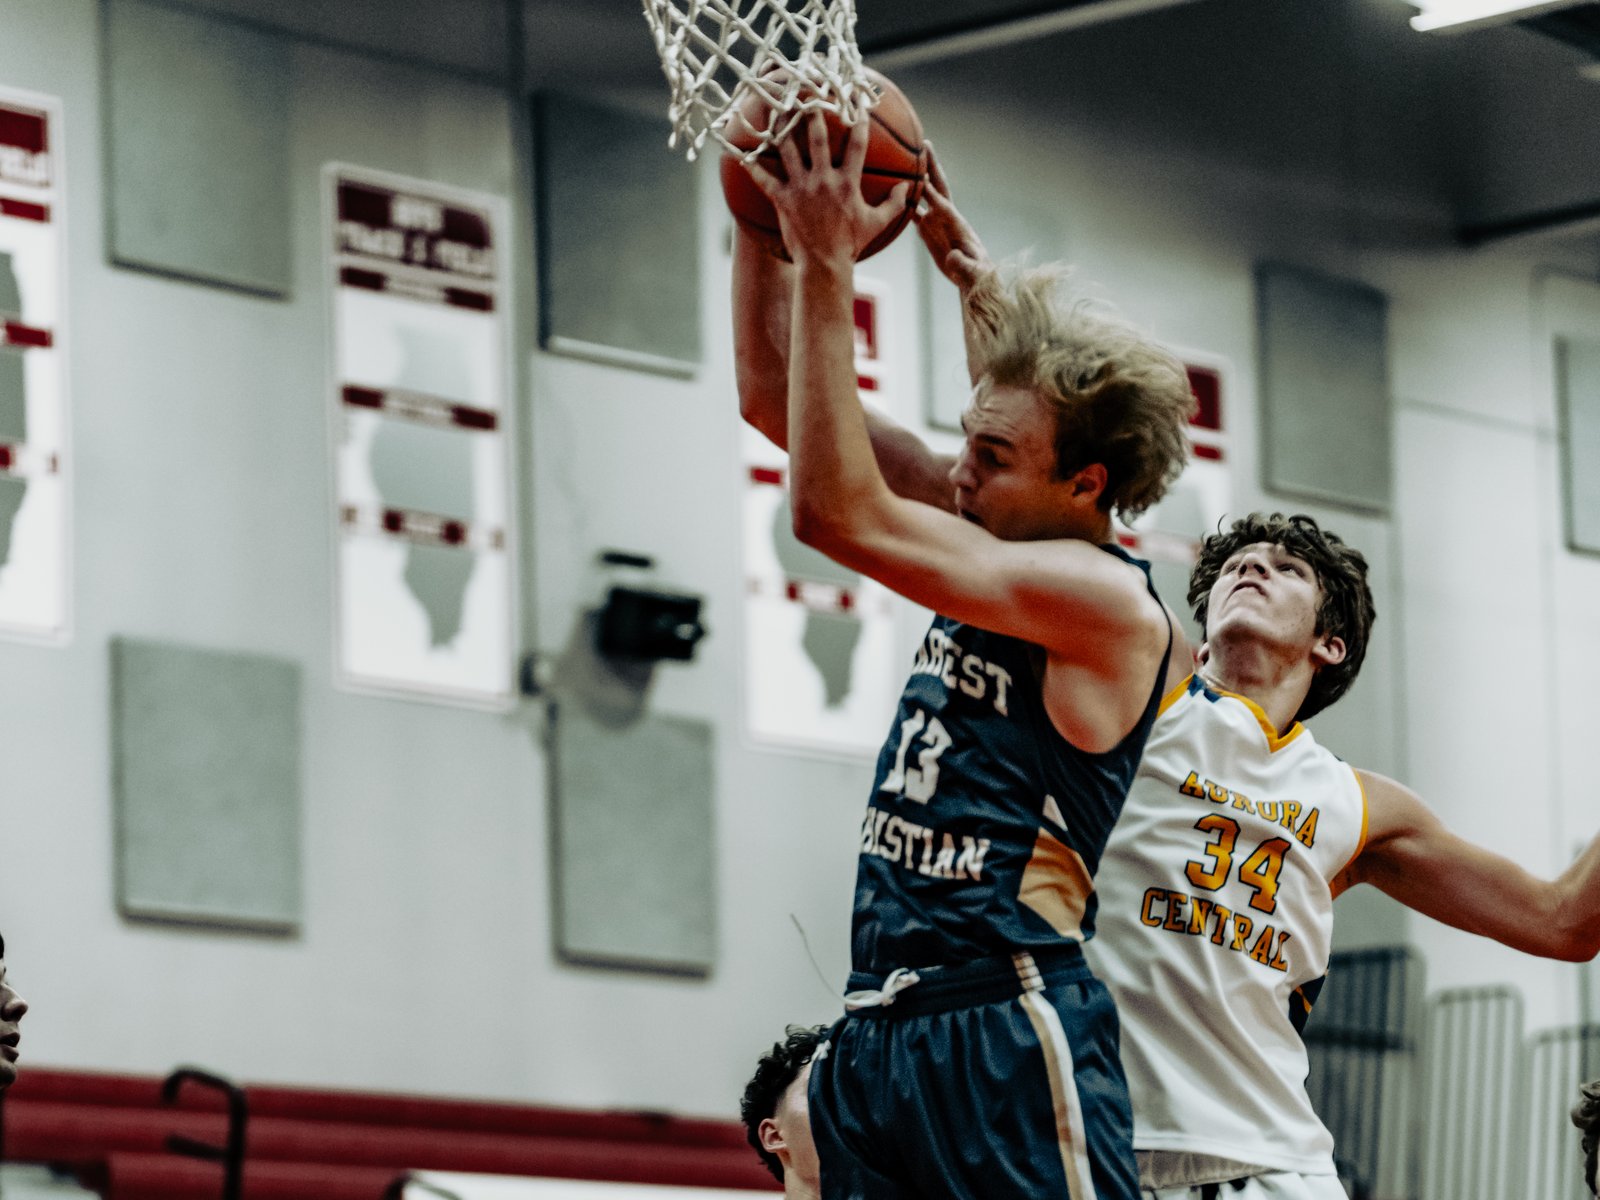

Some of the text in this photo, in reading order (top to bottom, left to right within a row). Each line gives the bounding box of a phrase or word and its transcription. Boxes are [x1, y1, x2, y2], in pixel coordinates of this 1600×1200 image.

[880, 708, 952, 805] 13
[1184, 813, 1292, 915] 34
[1140, 887, 1292, 973] CENTRAL
